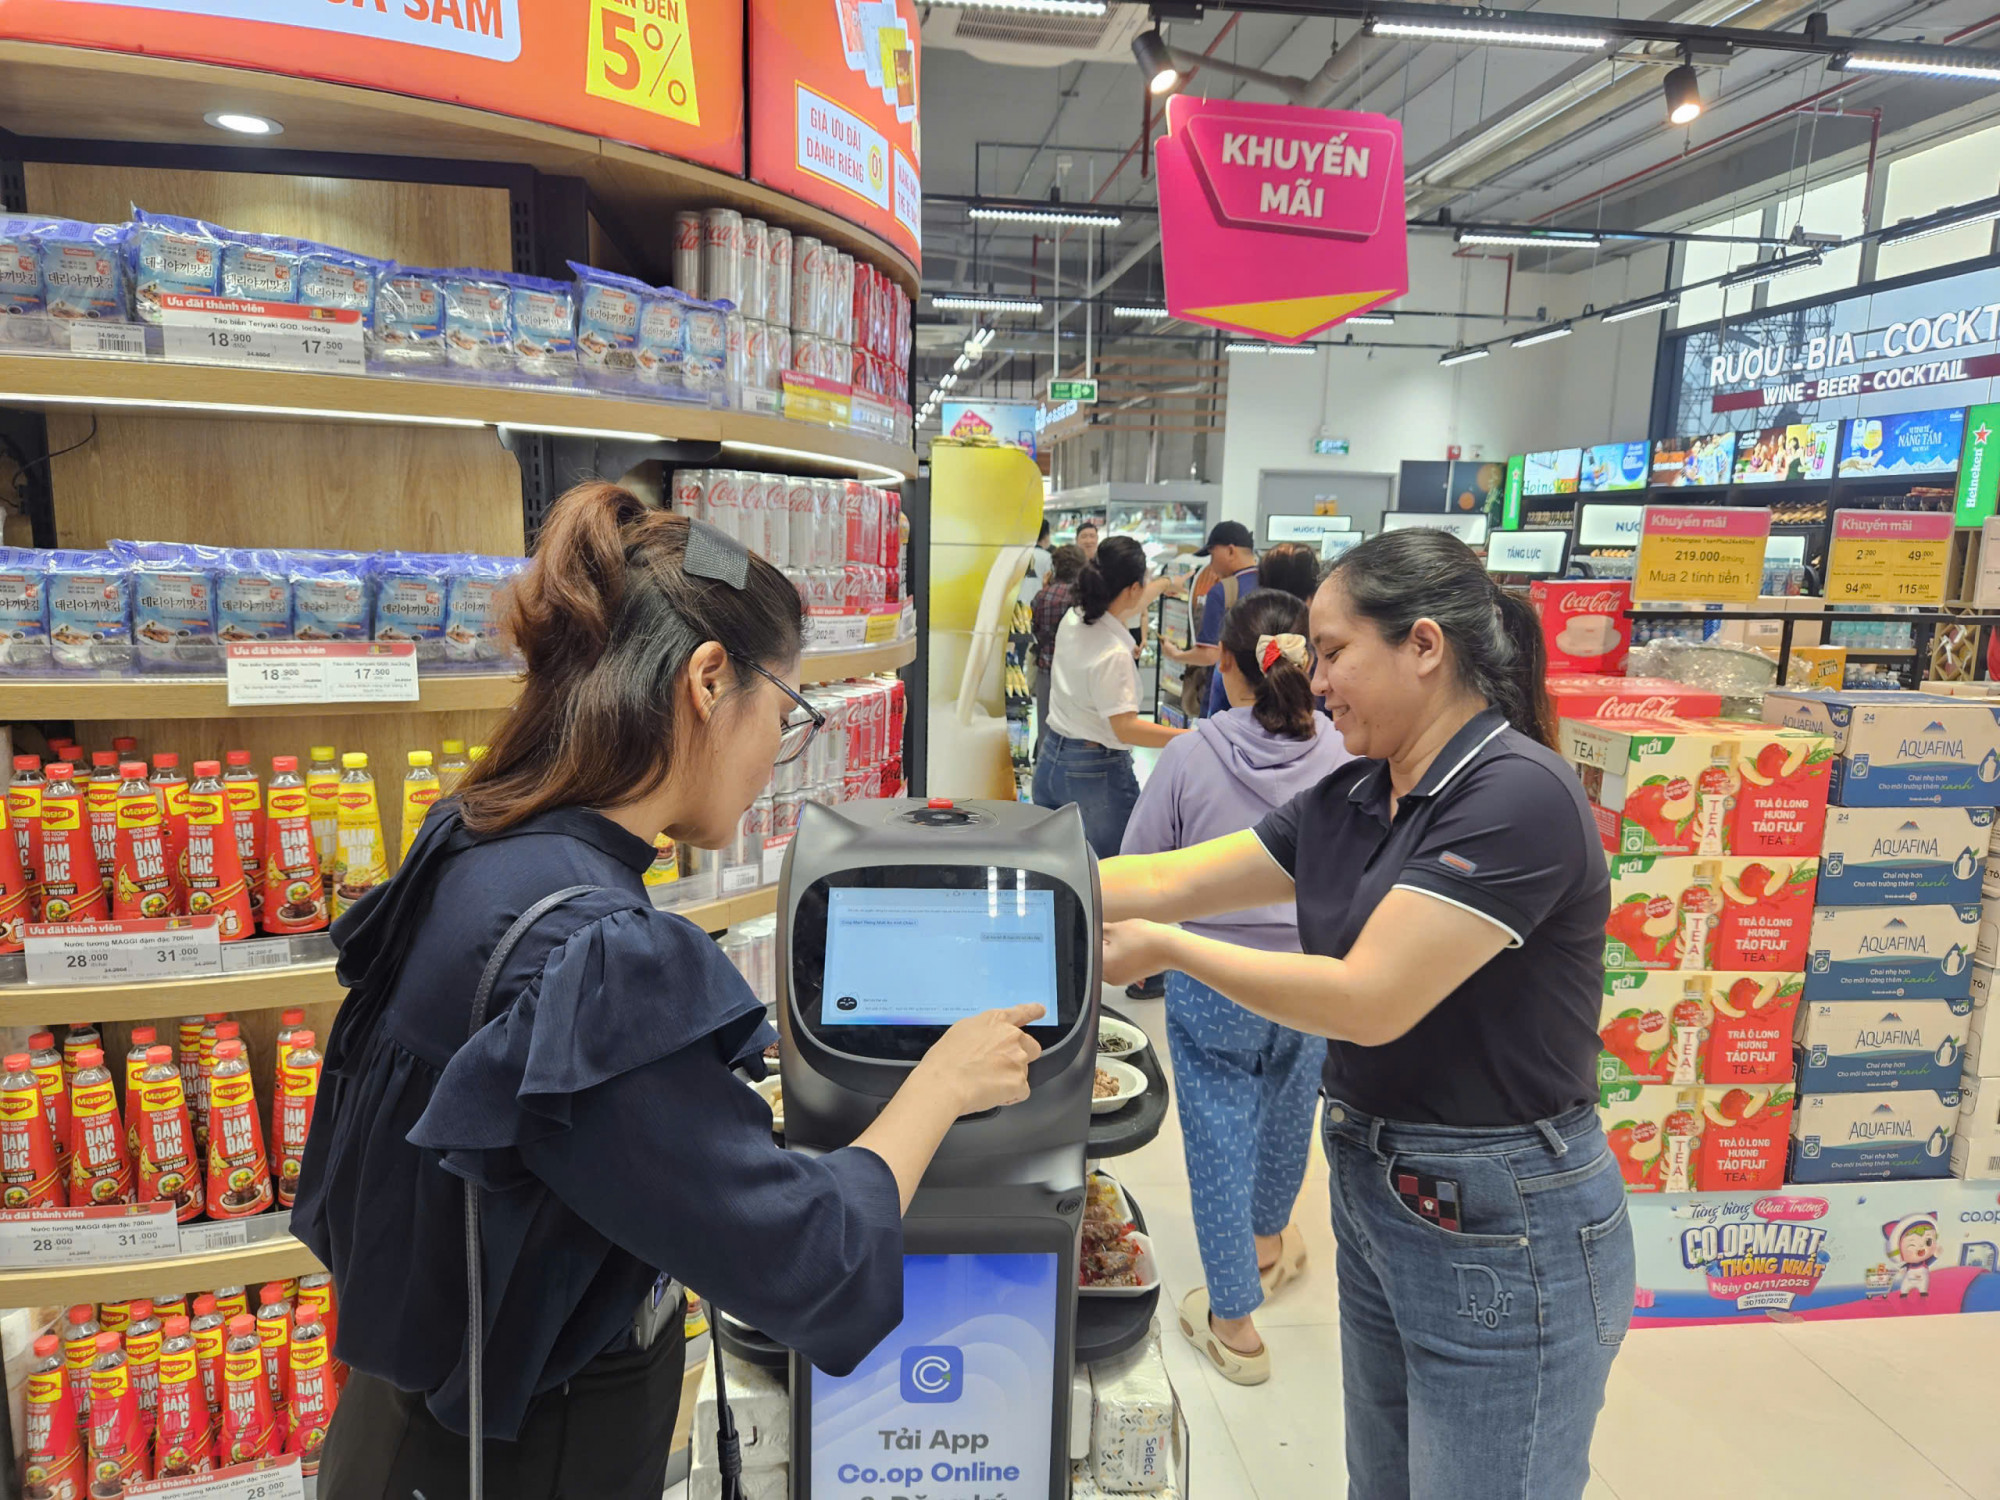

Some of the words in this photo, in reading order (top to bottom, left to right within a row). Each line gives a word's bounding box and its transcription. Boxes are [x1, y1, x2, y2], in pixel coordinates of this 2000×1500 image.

[600, 7, 687, 106] 5%
[811, 107, 828, 131] GIÁ
[806, 136, 835, 168] DÀNH
[1221, 132, 1369, 178] KHUYẾN
[872, 155, 883, 181] 01
[1260, 180, 1324, 218] MÃI
[167, 296, 184, 306] Ưu
[185, 297, 204, 308] đãi
[205, 299, 240, 311] thành
[248, 319, 278, 330] Teriyaki
[1709, 346, 1785, 387] RƯỢU
[1806, 331, 1855, 371] BIA
[1762, 382, 1805, 405] WINE
[1816, 373, 1861, 398] BEER
[1873, 359, 1968, 391] COCKTAIL
[1966, 447, 1984, 508] Heineken
[1652, 513, 1700, 530] Khuyến
[1703, 515, 1727, 529] mãi
[1841, 518, 1888, 534] Khuyến
[1890, 519, 1913, 531] mãi
[1675, 550, 1720, 562] 219.000
[1649, 569, 1676, 582] Mua
[1680, 570, 1688, 582] 2
[1692, 569, 1714, 583] tính
[1718, 568, 1739, 584] tiền
[1559, 590, 1621, 613] Coca-Cola
[1596, 695, 1678, 718] Coca-Cola
[1782, 715, 1824, 734] AQUAFINA
[1832, 710, 1848, 723] MỚI
[1863, 713, 1875, 721] 24
[1638, 739, 1662, 756] MỚI
[1897, 739, 1965, 759] AQUAFINA
[1878, 782, 1890, 790] Cho
[1908, 774, 1921, 782] Chai
[1754, 798, 1773, 808] TRÀ
[1783, 799, 1809, 808] LONG
[123, 806, 157, 817] Maggi
[1838, 813, 1849, 821] 24
[1973, 813, 1990, 824] MỚI
[1752, 820, 1776, 832] TÁO
[1776, 821, 1804, 832] FUJI
[1871, 838, 1939, 857] AQUAFINA
[137, 857, 164, 879] ĐẶC
[1619, 858, 1643, 874] MỚI
[1738, 917, 1757, 926] TRÀ
[1767, 918, 1793, 927] LONG
[1824, 911, 1835, 919] 24
[1960, 910, 1978, 921] MỚI
[29, 926, 45, 935] Ưu
[46, 925, 66, 935] đãi
[67, 924, 97, 934] thành
[111, 938, 138, 946] MAGGI
[172, 934, 194, 943] 700ml
[1735, 938, 1759, 950] TÁO
[1760, 939, 1787, 950] FUJI
[1858, 935, 1927, 954] AQUAFINA
[1612, 975, 1636, 990] MỚI
[1855, 1028, 1921, 1049] AQUAFINA
[145, 1087, 178, 1100] Maggi
[215, 1083, 248, 1096] Maggi
[1607, 1089, 1630, 1103] MỚI
[77, 1093, 110, 1106] Maggi
[1849, 1119, 1913, 1140] AQUAFINA
[155, 1138, 183, 1159] ĐẶC
[226, 1133, 253, 1155] ĐẶC
[1718, 1138, 1736, 1148] TRÀ
[1746, 1139, 1770, 1147] LONG
[88, 1142, 116, 1165] ĐẶC
[1717, 1159, 1739, 1170] TÁO
[1741, 1160, 1766, 1170] FUJI
[1756, 1199, 1785, 1212] Khai
[1686, 1224, 1826, 1265] CO.OPMART
[1720, 1247, 1777, 1278] THỐNG
[1781, 1253, 1825, 1278] NHẤT
[1712, 1281, 1741, 1295] Ngày
[1744, 1278, 1810, 1292] 04/11/2025
[1452, 1262, 1514, 1328] Dior
[1744, 1297, 1788, 1307] 30/10/2025
[878, 1427, 921, 1450] Tải
[929, 1429, 989, 1454] App
[1144, 1437, 1156, 1475] Select
[837, 1463, 923, 1487] Co.op
[931, 1461, 1020, 1483] Online
